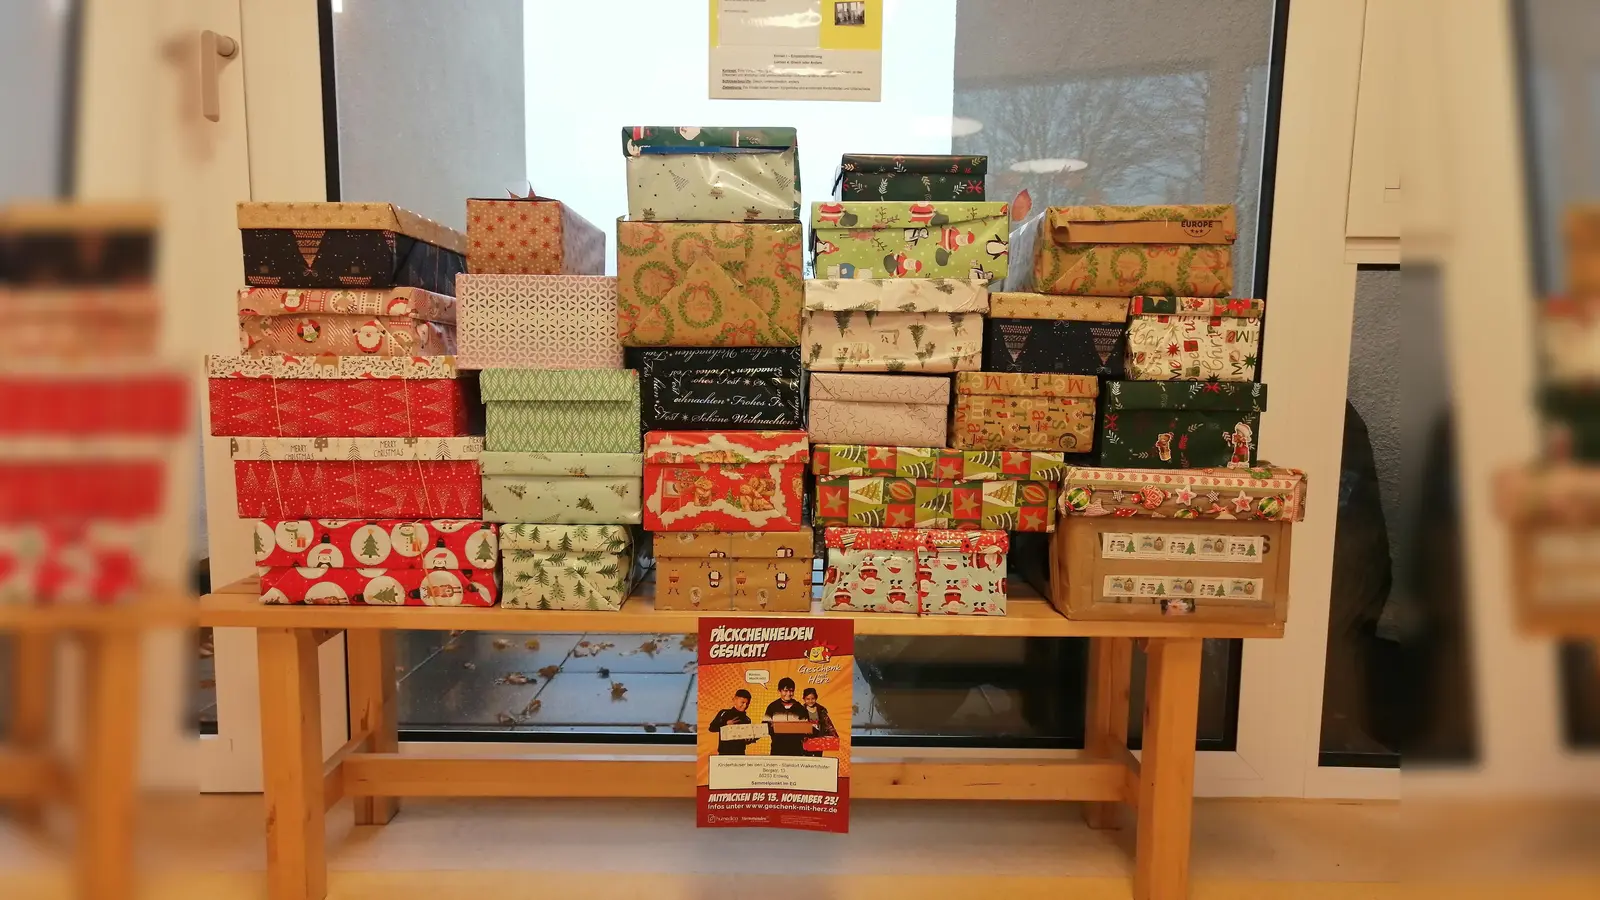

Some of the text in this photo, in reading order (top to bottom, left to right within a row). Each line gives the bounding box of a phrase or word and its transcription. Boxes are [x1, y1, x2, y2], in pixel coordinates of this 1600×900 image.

[691, 410, 729, 424] Schöne
[732, 412, 795, 426] Weihnachten
[290, 444, 307, 452] MERRY
[379, 440, 396, 448] MERRY
[284, 452, 314, 460] CHRISTMAS
[373, 448, 404, 458] CHRISTMAS
[710, 625, 814, 642] PÄCKCHENHELDEN
[709, 643, 770, 658] GESUCHT!
[798, 664, 842, 675] Geschenk
[808, 674, 830, 684] Herz
[708, 792, 840, 806] MITPACKEN BIS 13. NOVEMBER 23!
[746, 804, 838, 813] www.geschenk-mit-herz.de
